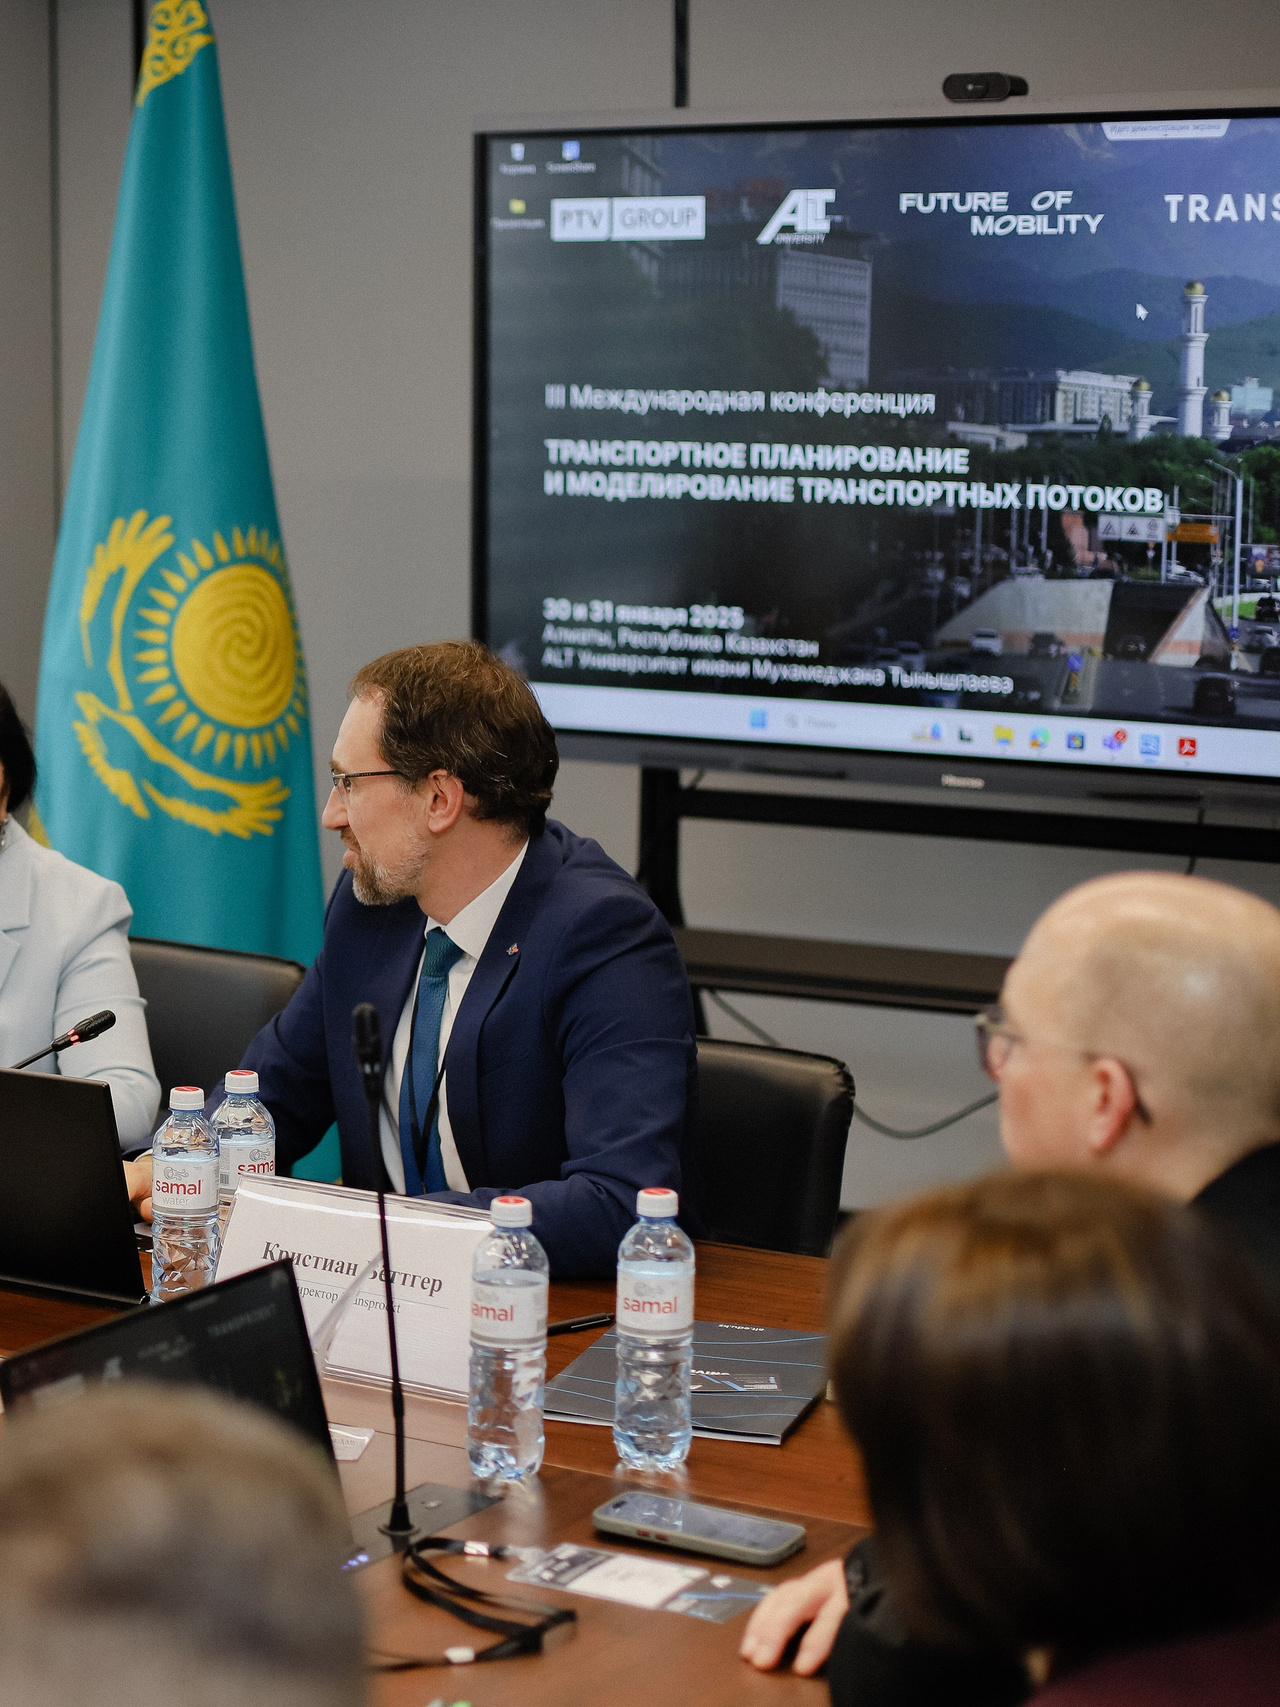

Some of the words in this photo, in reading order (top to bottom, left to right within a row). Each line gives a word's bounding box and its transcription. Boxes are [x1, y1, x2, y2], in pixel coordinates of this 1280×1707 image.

[899, 191, 1009, 214] FUTURE
[1030, 190, 1074, 212] OF
[560, 208, 603, 230] PTV
[621, 207, 698, 230] GROUP
[970, 213, 1106, 236] MOBILITY
[545, 383, 566, 409] III
[569, 384, 765, 416] Международная
[770, 387, 935, 418] конференция
[544, 438, 747, 469] ТРАНСПОРТНОЕ
[749, 442, 970, 474] ПЛАНИРОВАНИЕ
[543, 470, 565, 496] И
[566, 470, 795, 502] МОДЕЛИРОВАНИЕ
[797, 476, 1021, 509] ТРАНСПОРТНЫХ
[1026, 483, 1164, 513] ПОТОКОВ
[542, 597, 571, 621] 30
[589, 599, 614, 623] 31
[689, 604, 745, 630] 2025
[237, 1160, 274, 1176] sama
[155, 1179, 202, 1195] samal
[162, 1196, 190, 1207] water
[261, 1241, 359, 1278] Кристиан
[297, 1285, 339, 1304] иректор
[622, 1297, 678, 1315] samal
[471, 1302, 515, 1323] amal
